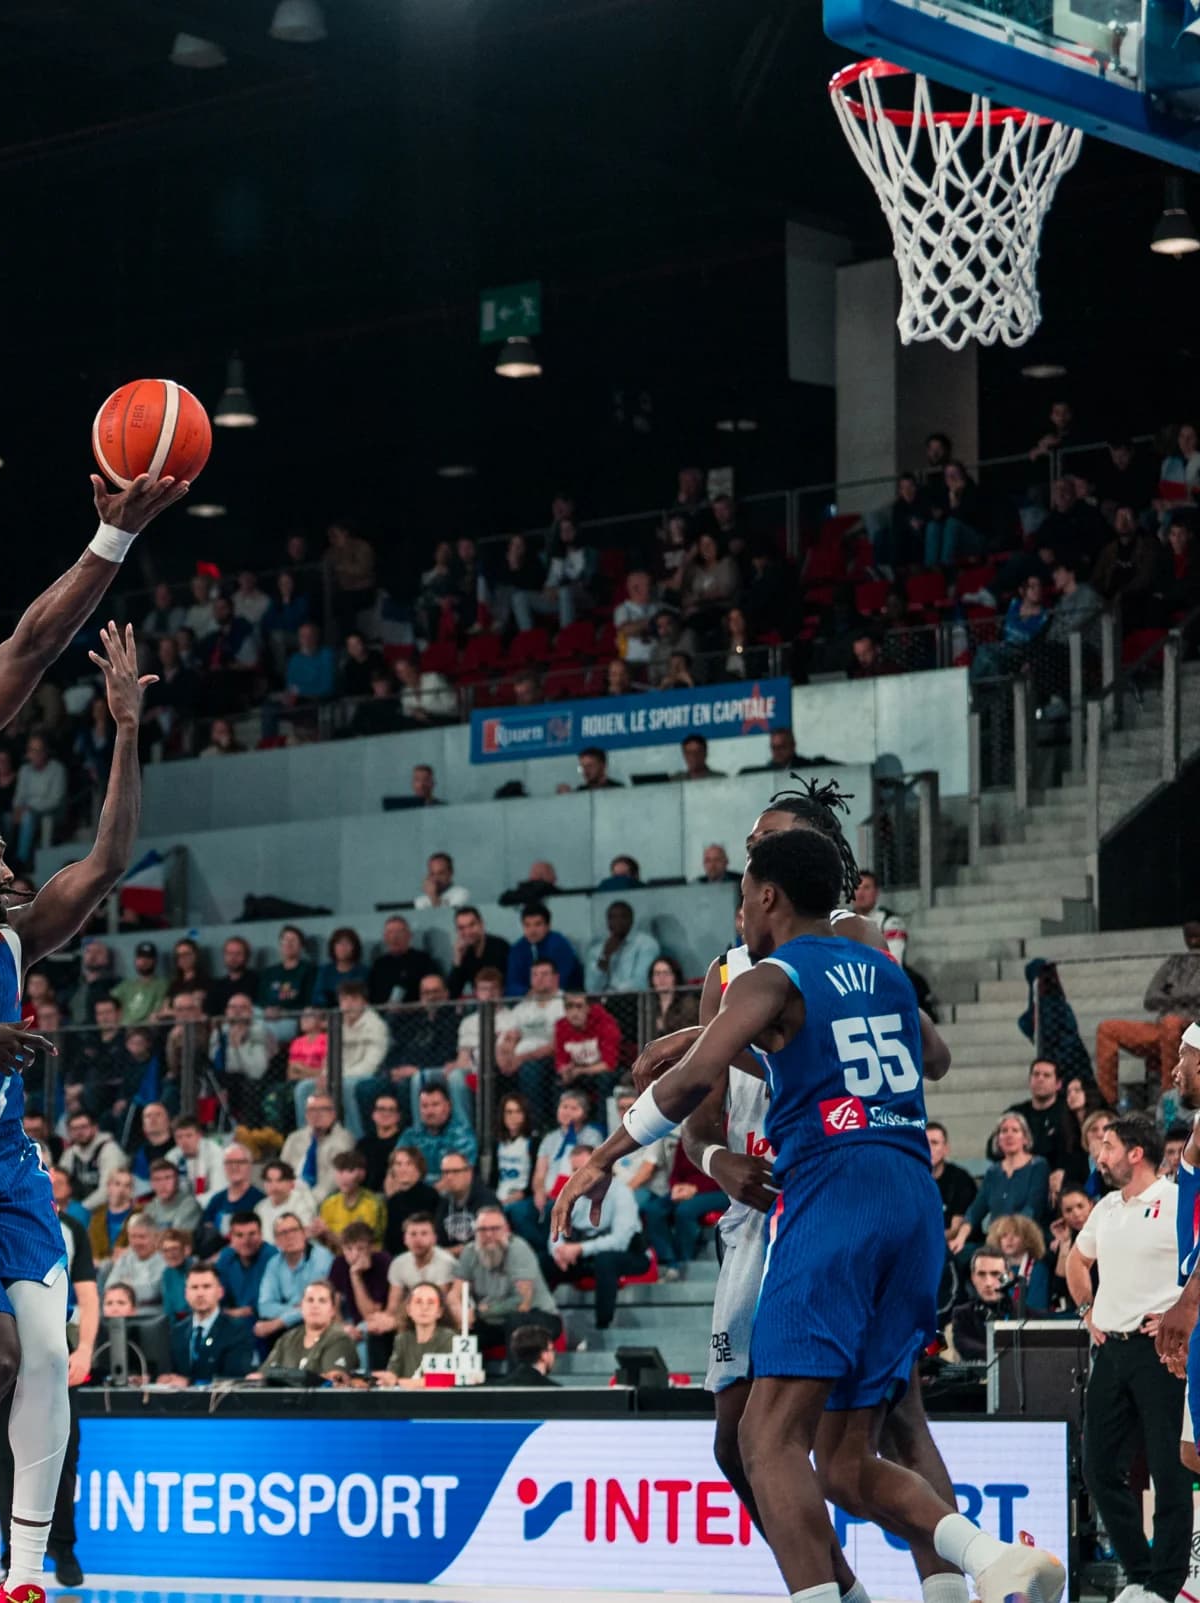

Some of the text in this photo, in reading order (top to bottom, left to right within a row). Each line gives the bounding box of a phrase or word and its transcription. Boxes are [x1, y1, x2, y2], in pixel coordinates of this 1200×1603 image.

[630, 708, 646, 732] LE
[649, 704, 692, 730] SPORT
[693, 702, 710, 726] EN
[713, 696, 776, 724] CAPITALE
[825, 962, 876, 997] AYAYI
[831, 1013, 919, 1097] 55
[460, 1338, 470, 1353] 2
[89, 1469, 459, 1539] INTERSPORT
